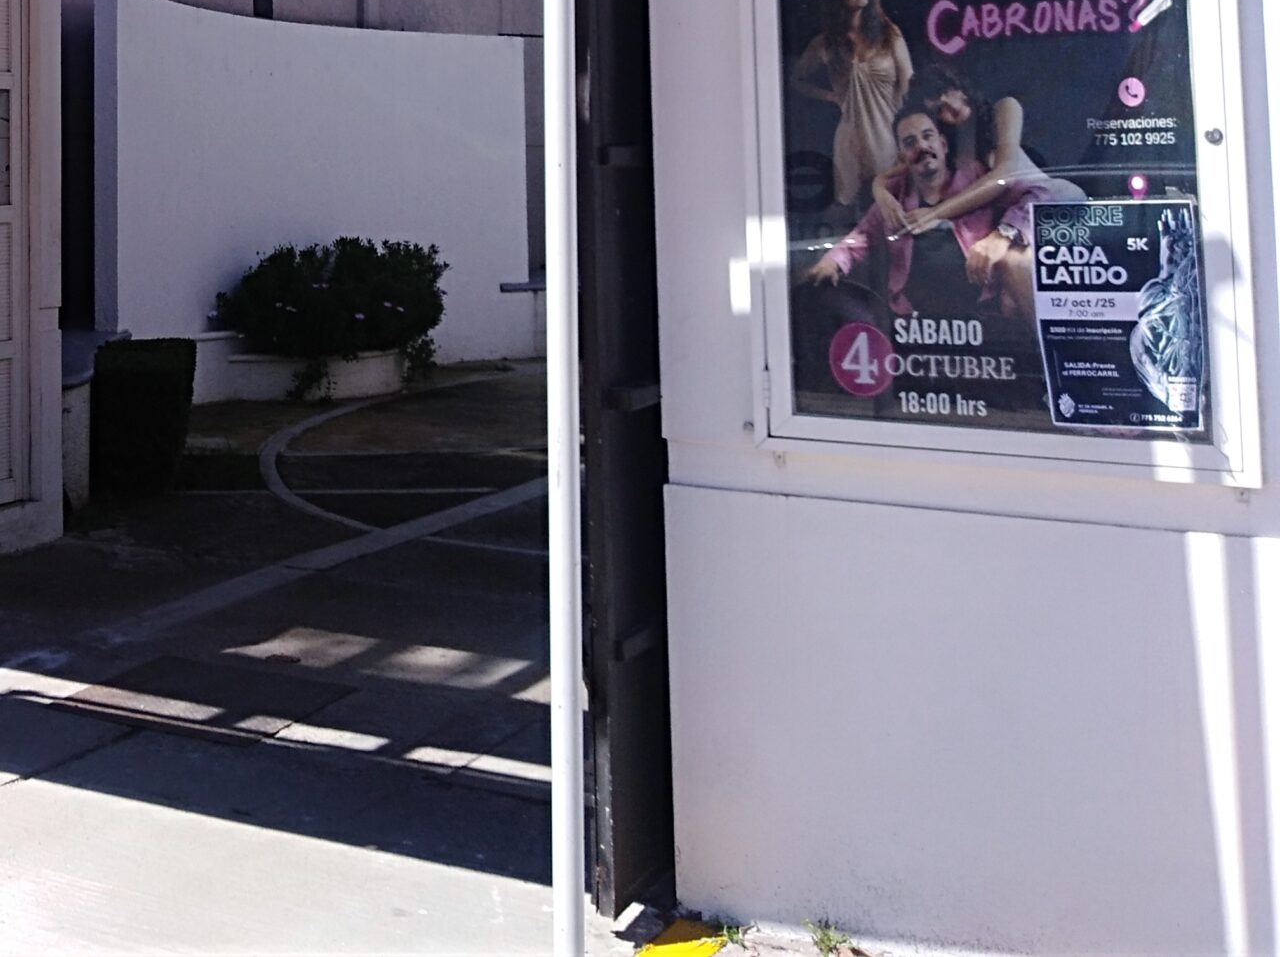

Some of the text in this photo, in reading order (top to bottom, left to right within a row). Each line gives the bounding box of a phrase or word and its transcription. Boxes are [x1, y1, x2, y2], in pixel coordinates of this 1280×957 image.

[1086, 116, 1177, 130] Reservaciones:
[1095, 132, 1176, 146] 775 102 9925
[1037, 205, 1123, 226] CORRE
[1037, 225, 1092, 246] POR
[1126, 237, 1149, 251] 5K
[1038, 246, 1109, 265] CADA
[1040, 266, 1128, 285] LATIDO
[1072, 298, 1092, 308] oct
[894, 310, 984, 347] SÁBADO
[841, 331, 878, 385] 4
[884, 354, 1016, 381] OCTUBRE
[1069, 369, 1120, 378] FERROCARRIL
[899, 390, 988, 417] 18:00 hrs
